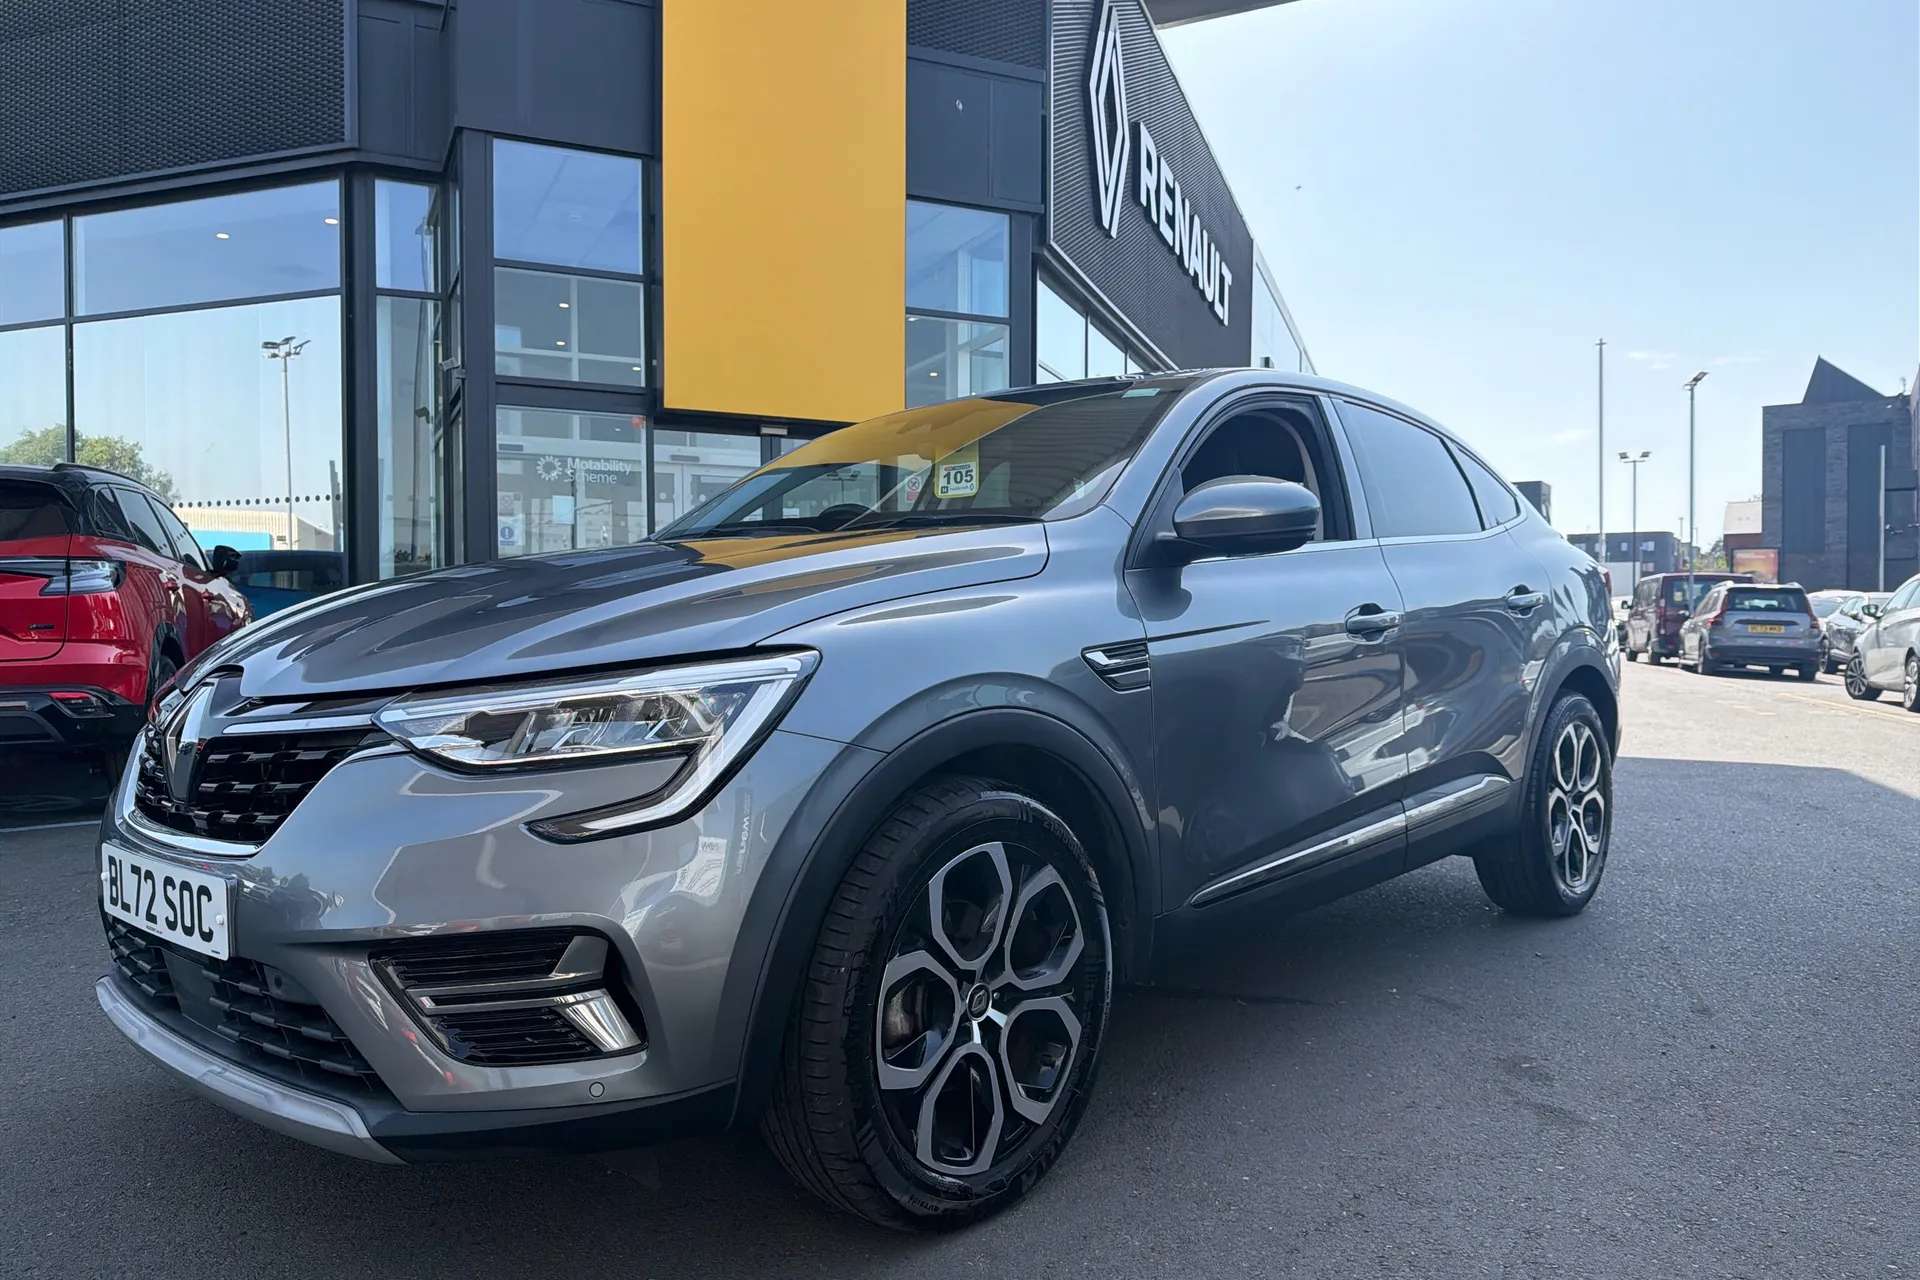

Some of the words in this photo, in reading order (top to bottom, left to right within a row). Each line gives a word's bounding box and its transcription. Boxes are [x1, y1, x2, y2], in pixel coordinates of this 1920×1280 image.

[1139, 121, 1232, 326] RENAULT
[567, 457, 631, 475] Motability
[944, 469, 973, 485] 105
[108, 854, 157, 925] BL72
[163, 875, 214, 943] SOC
